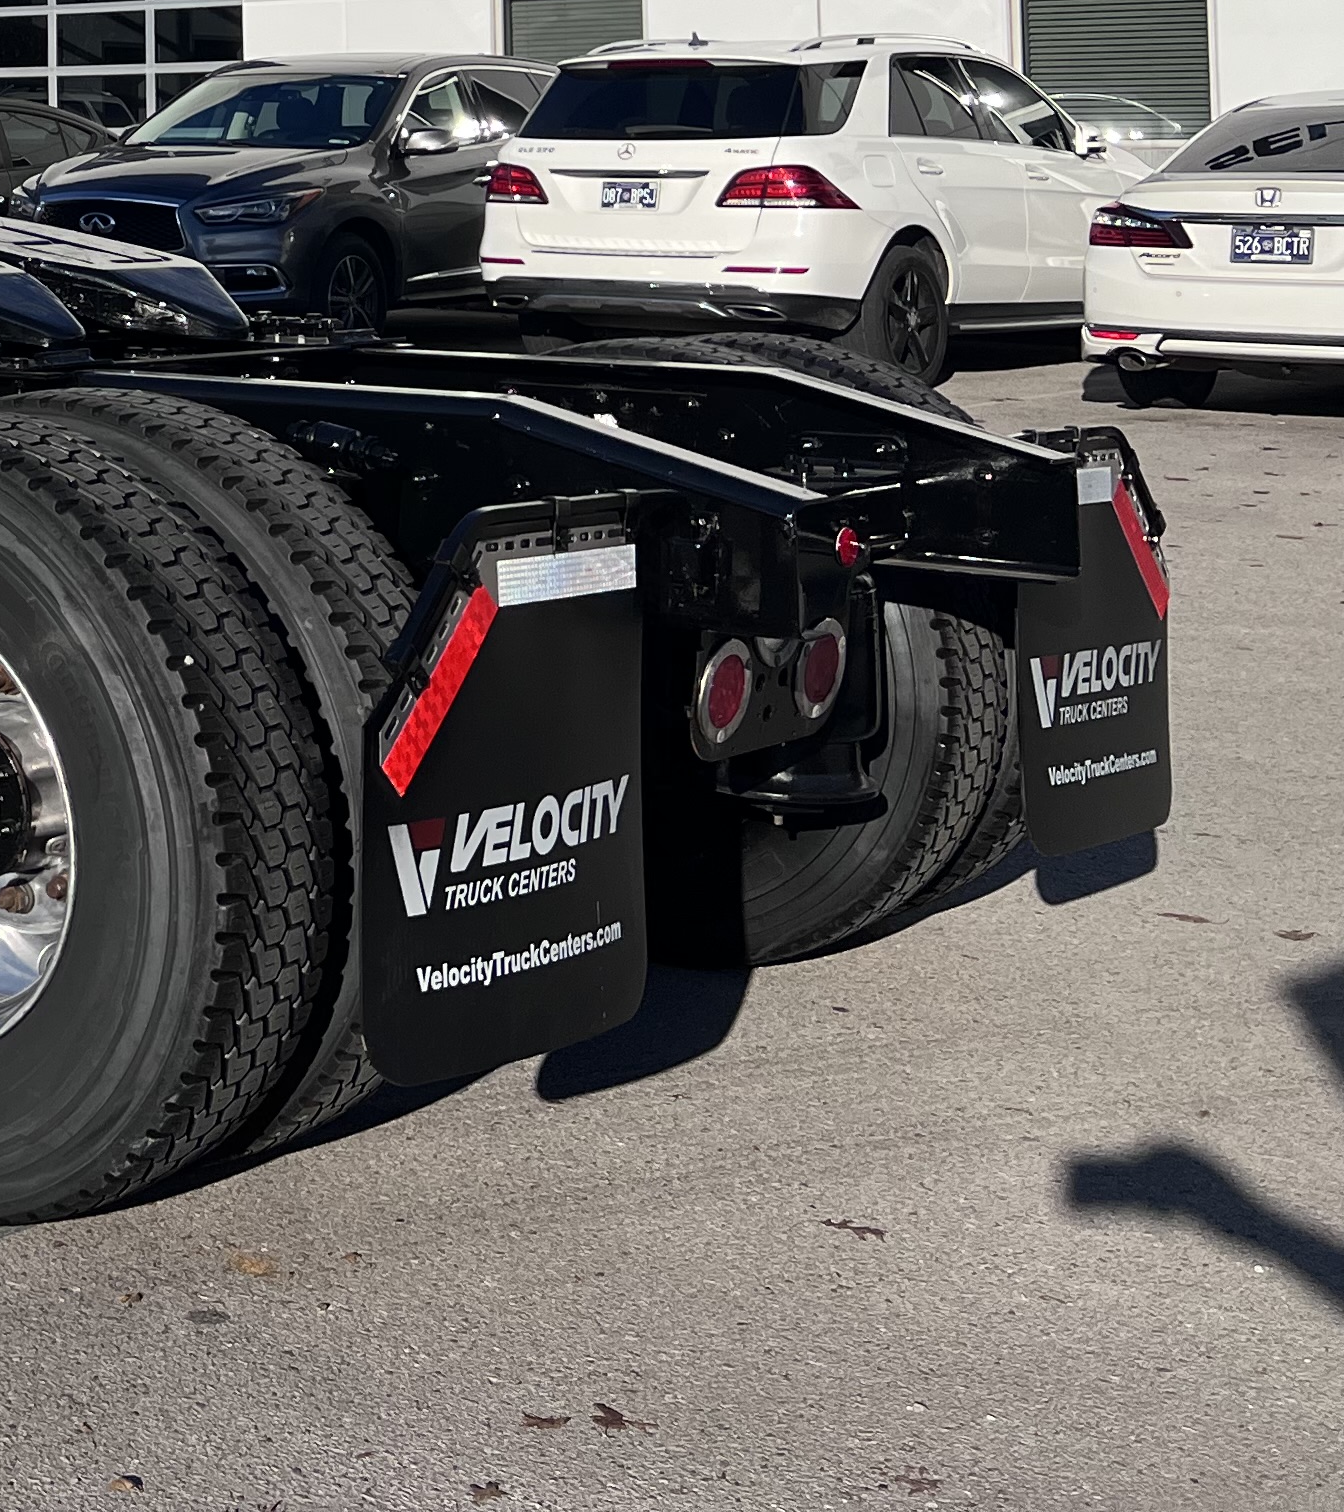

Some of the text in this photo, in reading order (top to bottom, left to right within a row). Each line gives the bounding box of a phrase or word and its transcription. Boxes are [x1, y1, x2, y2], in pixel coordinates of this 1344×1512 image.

[1235, 236, 1310, 255] 526 BCTR
[1060, 638, 1163, 698] VELOCITY
[1058, 695, 1129, 727] TRUCK CENTERS
[1047, 748, 1158, 787] VelocityTruckCenters.com
[450, 774, 630, 874] VELOCITY
[443, 858, 577, 911] TRUCK CENTERS
[416, 919, 623, 993] VelocityTruckCenters.com
